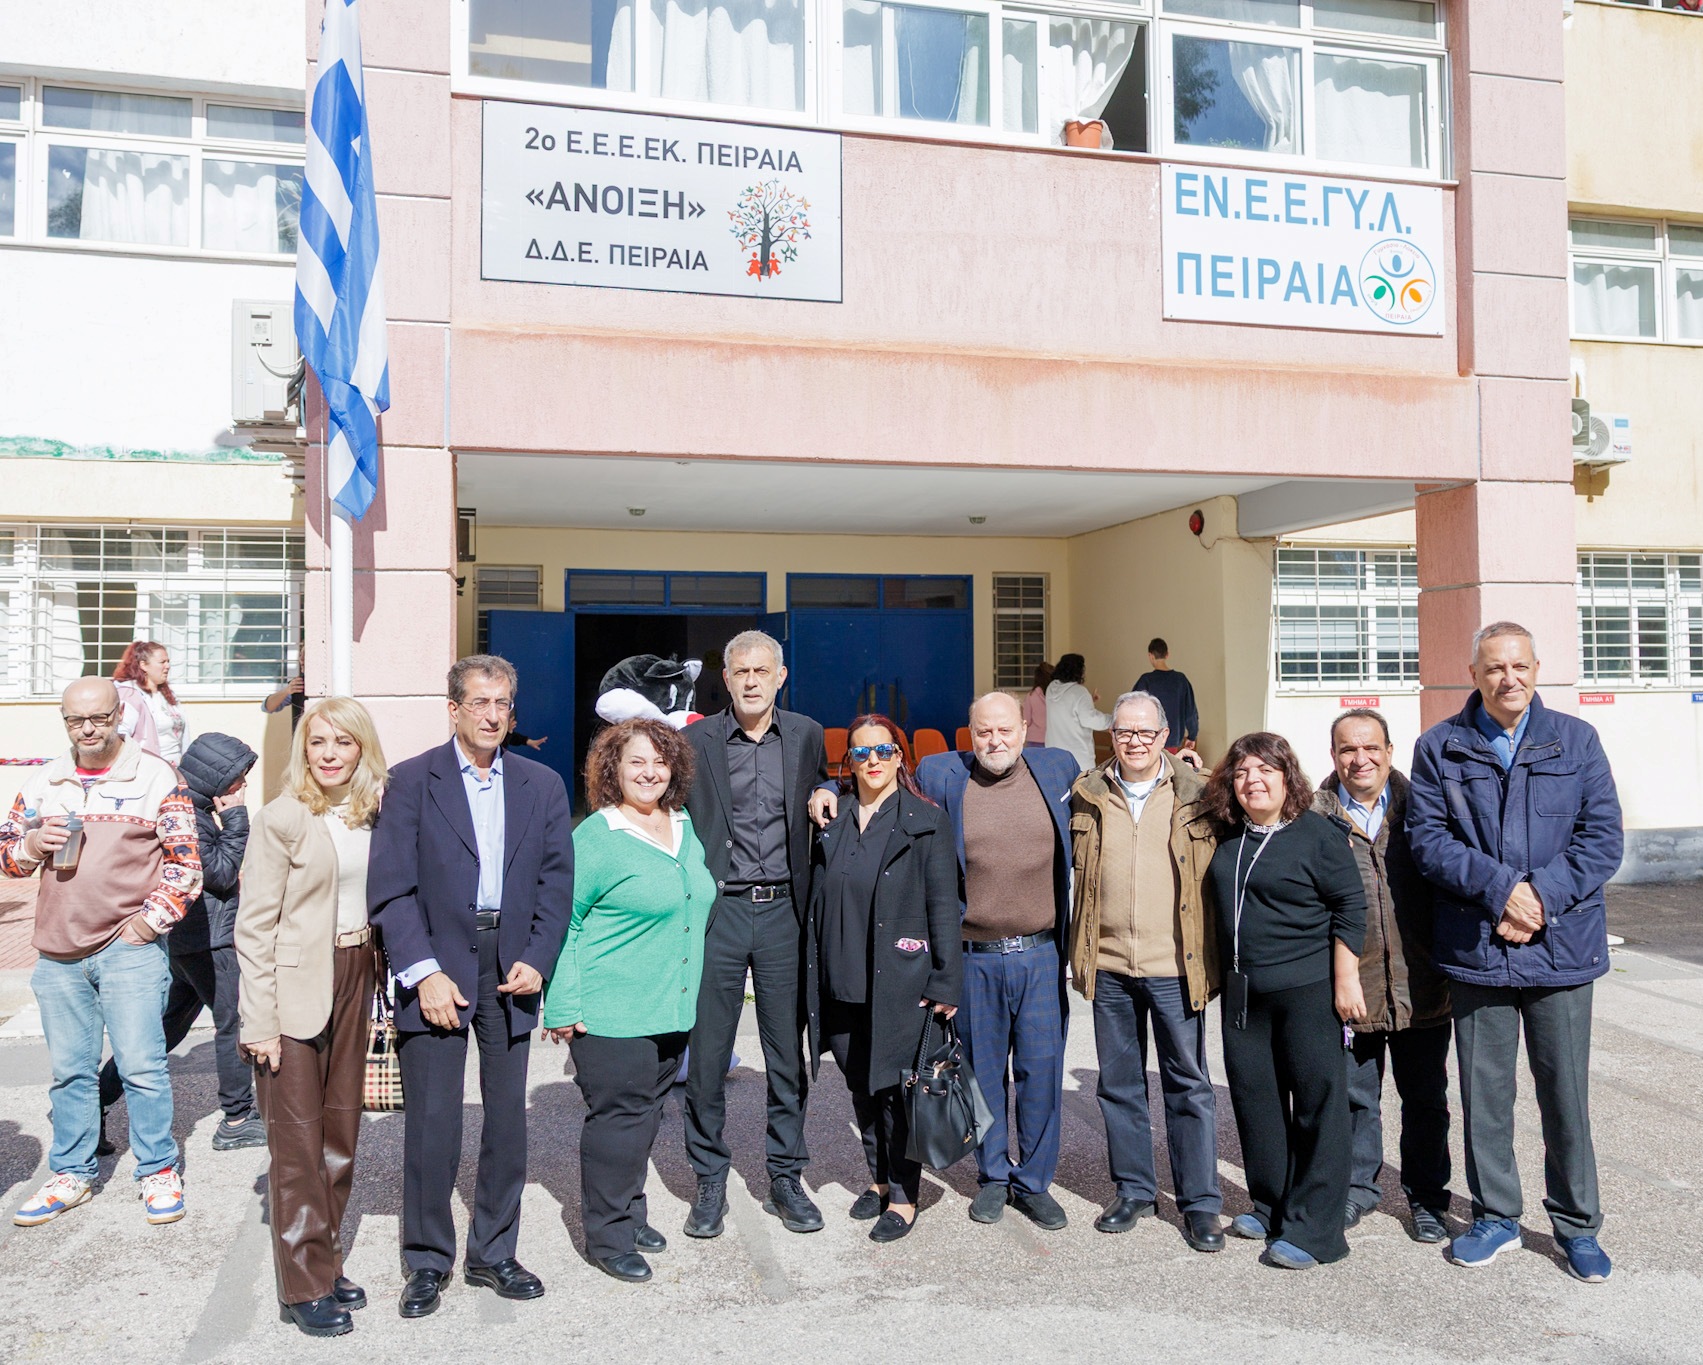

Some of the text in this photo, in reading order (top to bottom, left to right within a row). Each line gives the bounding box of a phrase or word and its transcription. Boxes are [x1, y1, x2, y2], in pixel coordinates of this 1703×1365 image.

[525, 127, 803, 173] 2ο Ε.Ε.Ε.ΕΚ. ΠΕΙΡΑΙΑ
[525, 181, 706, 220] «ΑΝΟΙΞΗ»
[1175, 171, 1412, 235] ΕΝ.Ε.Ε.ΓΥ.Λ.
[524, 238, 709, 272] Δ.Δ.Ε. ΠΕΙΡΑΙΑ
[1176, 251, 1359, 307] ΠΕΙΡΑΙΑ
